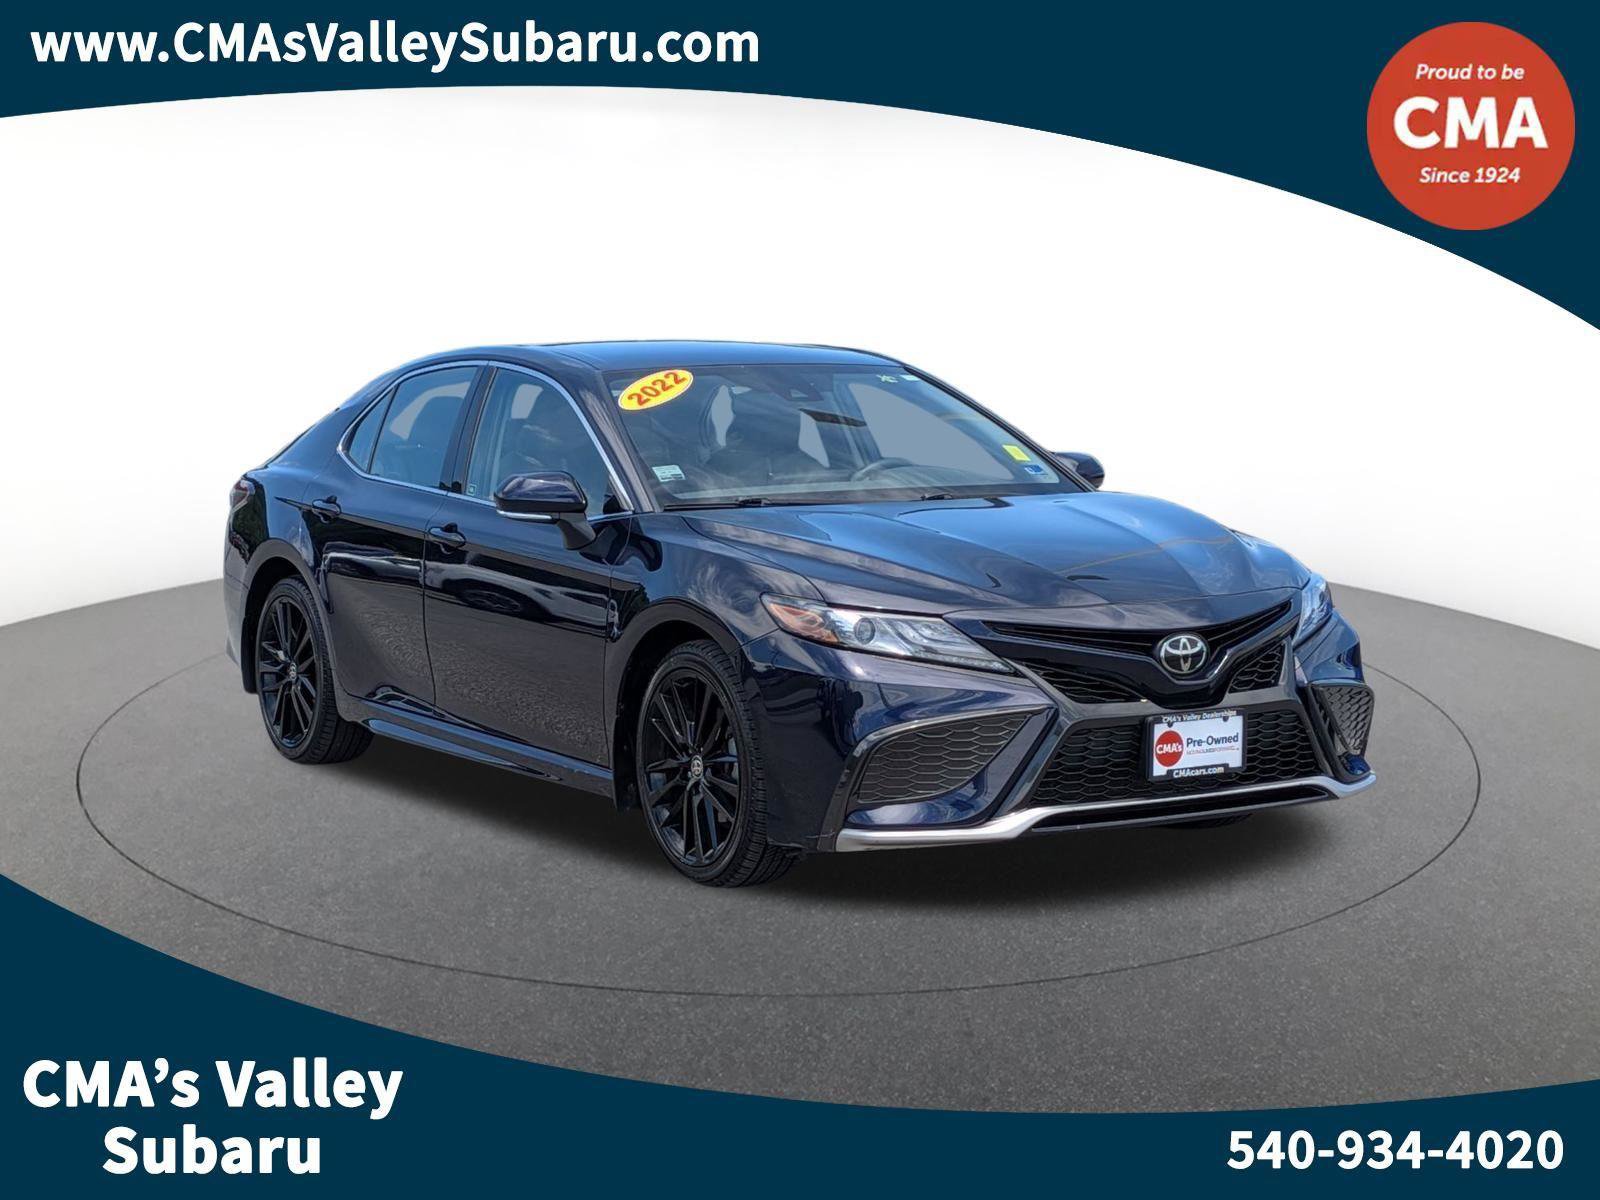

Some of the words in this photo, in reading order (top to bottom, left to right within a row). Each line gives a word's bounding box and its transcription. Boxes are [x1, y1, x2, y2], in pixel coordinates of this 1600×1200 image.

[627, 371, 687, 406] 2022
[1186, 732, 1239, 748] Pre-Owned
[1156, 742, 1182, 754] CMA's
[1173, 766, 1225, 778] CMAcars.com
